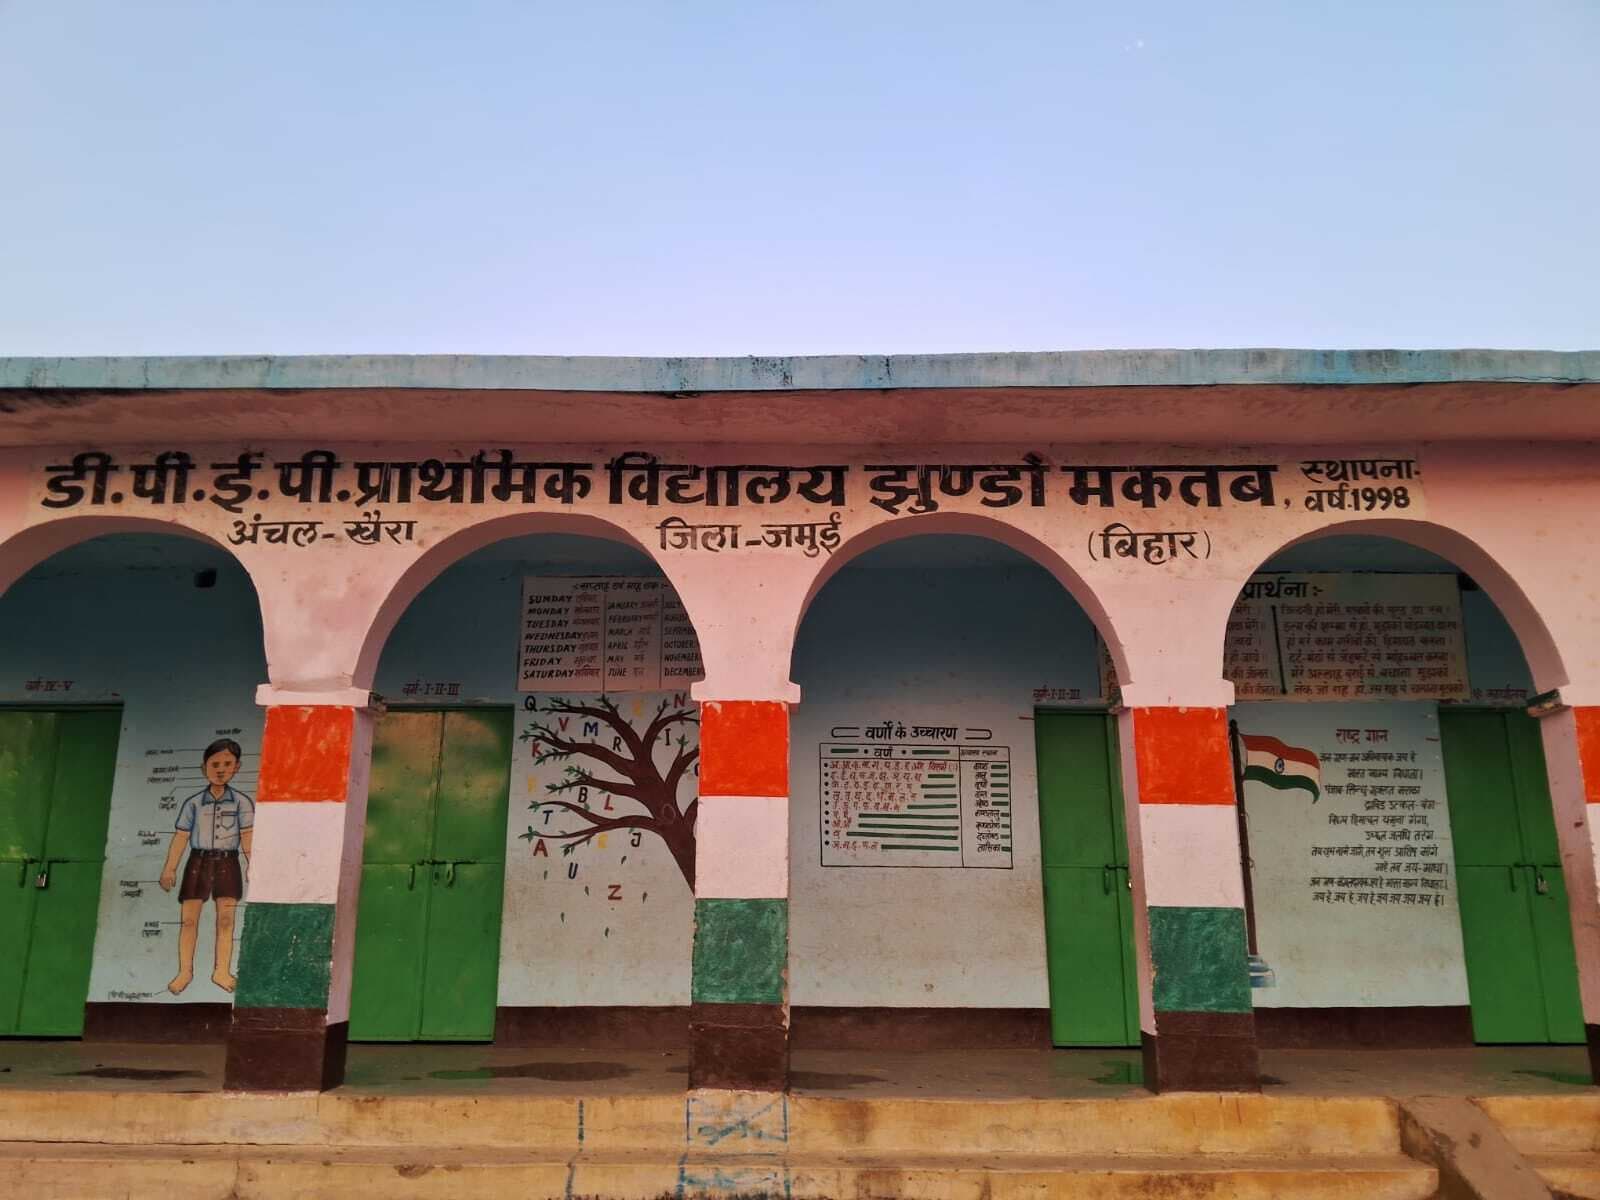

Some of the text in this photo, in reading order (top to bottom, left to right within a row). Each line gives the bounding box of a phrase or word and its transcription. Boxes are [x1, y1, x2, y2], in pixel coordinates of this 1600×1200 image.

[605, 452, 849, 507] विद्यालय
[528, 595, 572, 604] SUNDAY
[527, 607, 569, 616] MONDAY
[527, 619, 568, 628] TUESDAY
[525, 632, 583, 640] WEDNESDAY
[526, 644, 577, 653] THURSDAY
[524, 657, 562, 666] FRIDAY
[523, 669, 574, 679] SATURDAY
[608, 668, 627, 677] JUNE
[525, 696, 537, 711] Q
[673, 694, 685, 708] N
[558, 717, 569, 732] V
[584, 721, 598, 737] M
[895, 721, 908, 739] के
[911, 726, 958, 741] उच्चारण
[532, 741, 542, 757] K
[613, 737, 622, 752] R
[579, 787, 588, 803] B
[604, 795, 614, 811] L
[543, 810, 553, 825] T
[631, 833, 640, 847] J
[533, 839, 549, 857] A
[569, 861, 578, 880] U
[608, 885, 623, 900] Z
